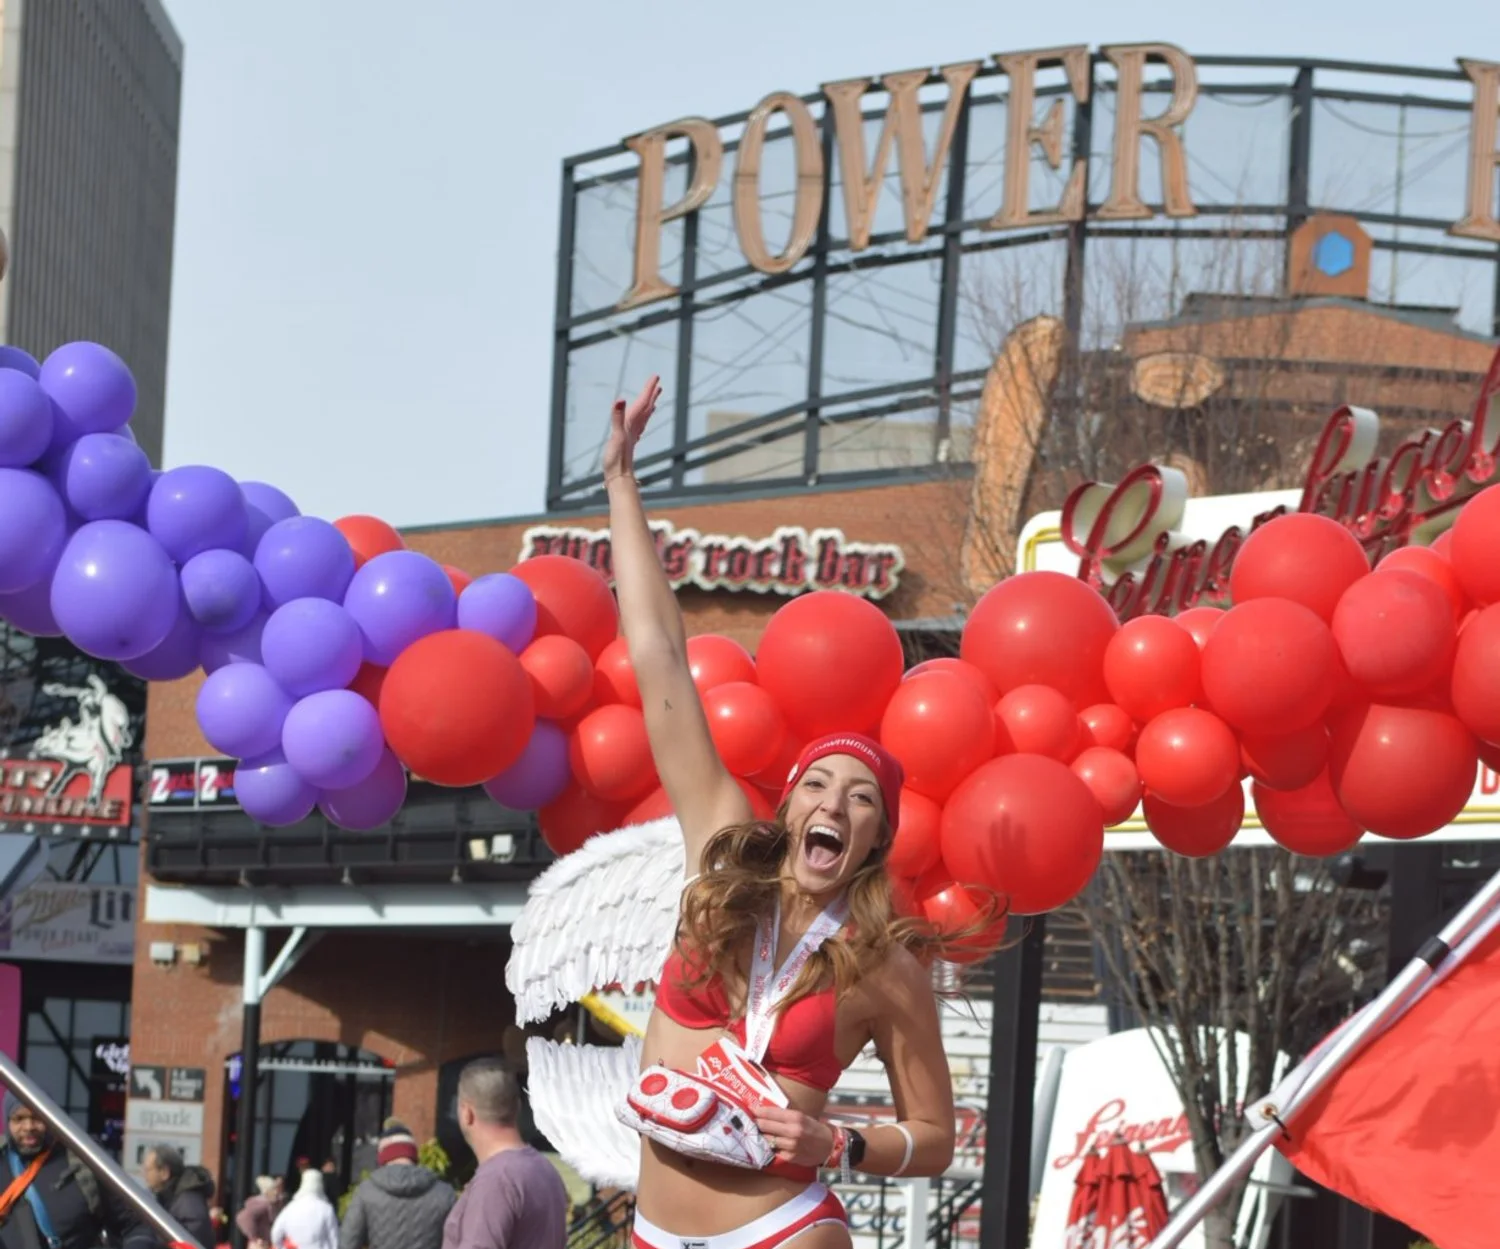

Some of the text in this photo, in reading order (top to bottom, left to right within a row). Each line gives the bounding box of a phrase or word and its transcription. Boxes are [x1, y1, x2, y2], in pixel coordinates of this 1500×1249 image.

[616, 41, 1199, 311] POWER
[702, 532, 807, 586] rock
[812, 529, 897, 592] bar
[138, 1107, 191, 1129] spark
